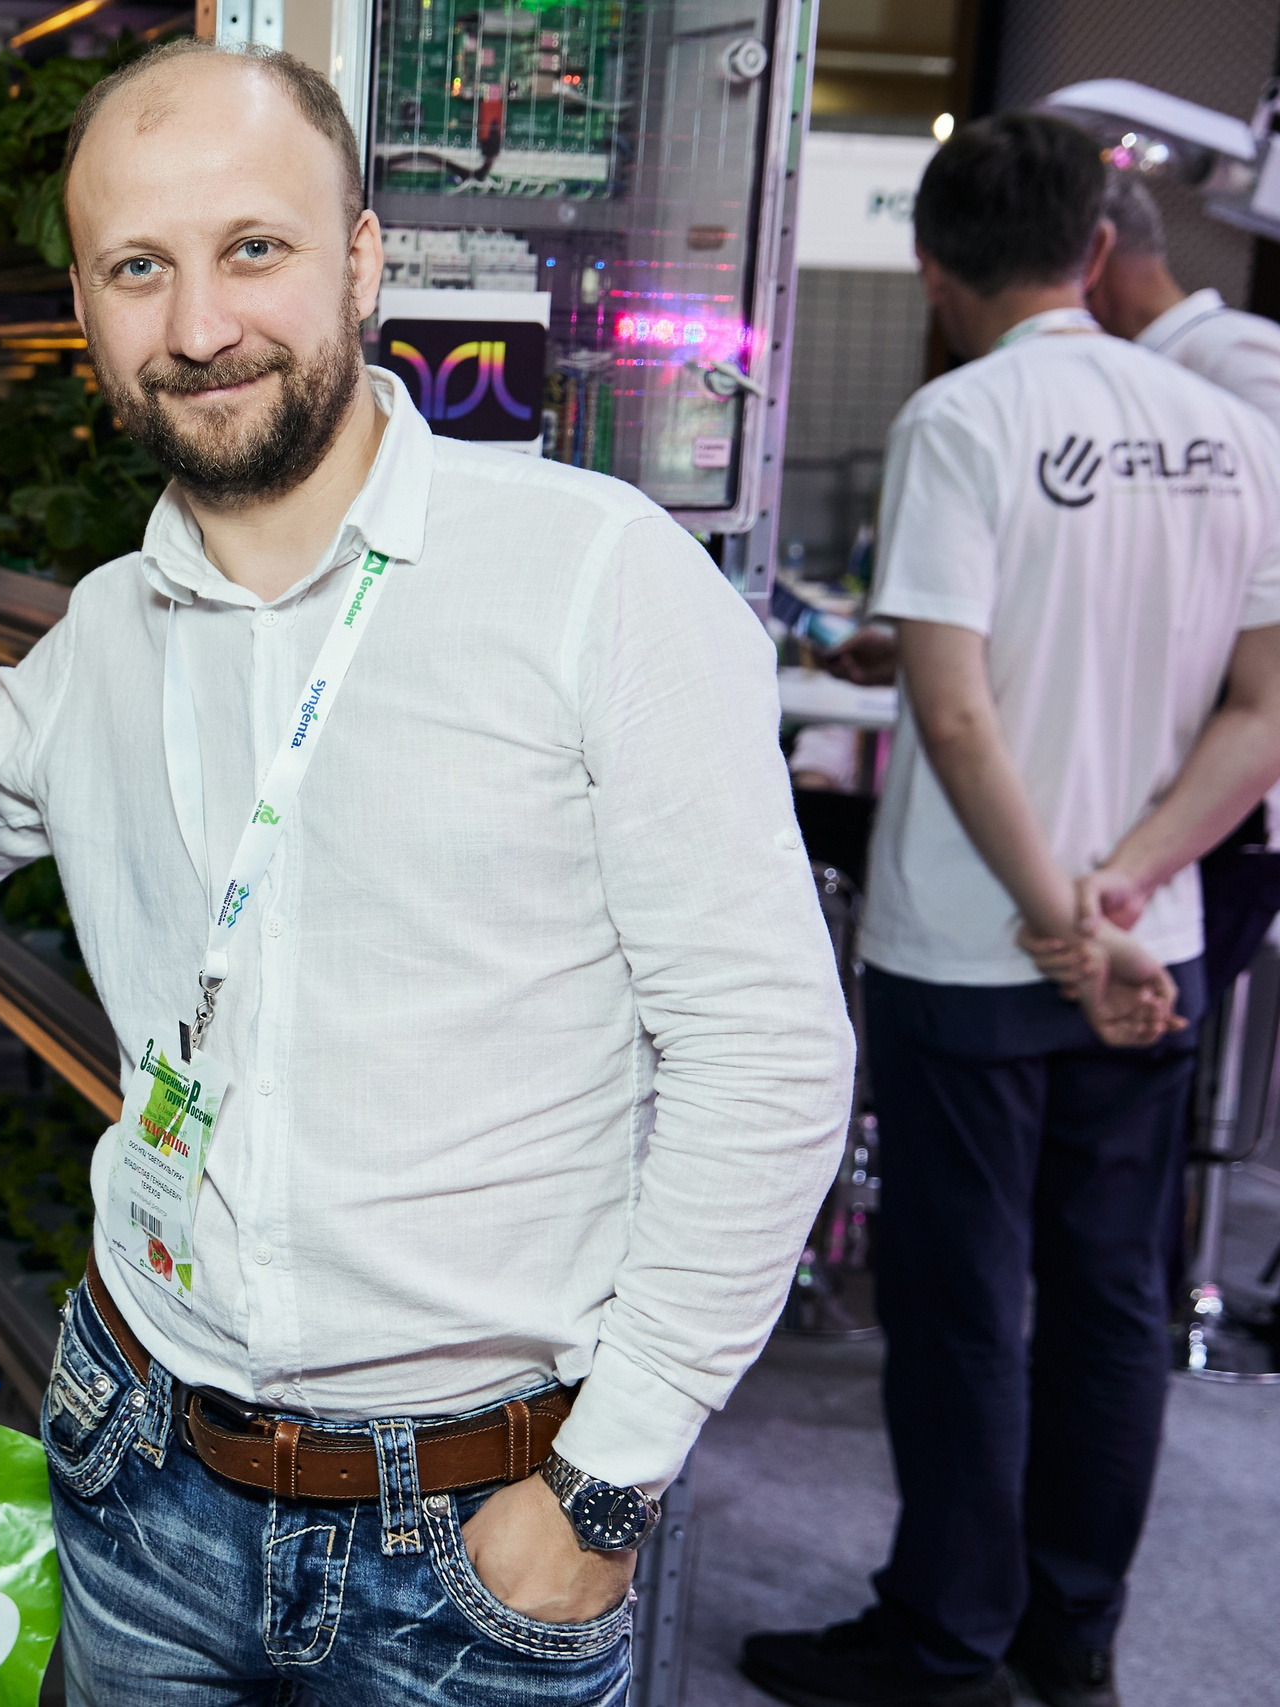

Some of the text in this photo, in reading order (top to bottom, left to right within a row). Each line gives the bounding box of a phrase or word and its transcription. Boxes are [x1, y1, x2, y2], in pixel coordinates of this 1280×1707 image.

[344, 576, 373, 626] Grodan
[140, 1038, 190, 1097] Защищенный
[165, 1088, 186, 1109] грунт
[186, 1080, 213, 1128] России
[138, 1114, 190, 1158] УЧАСТНИК
